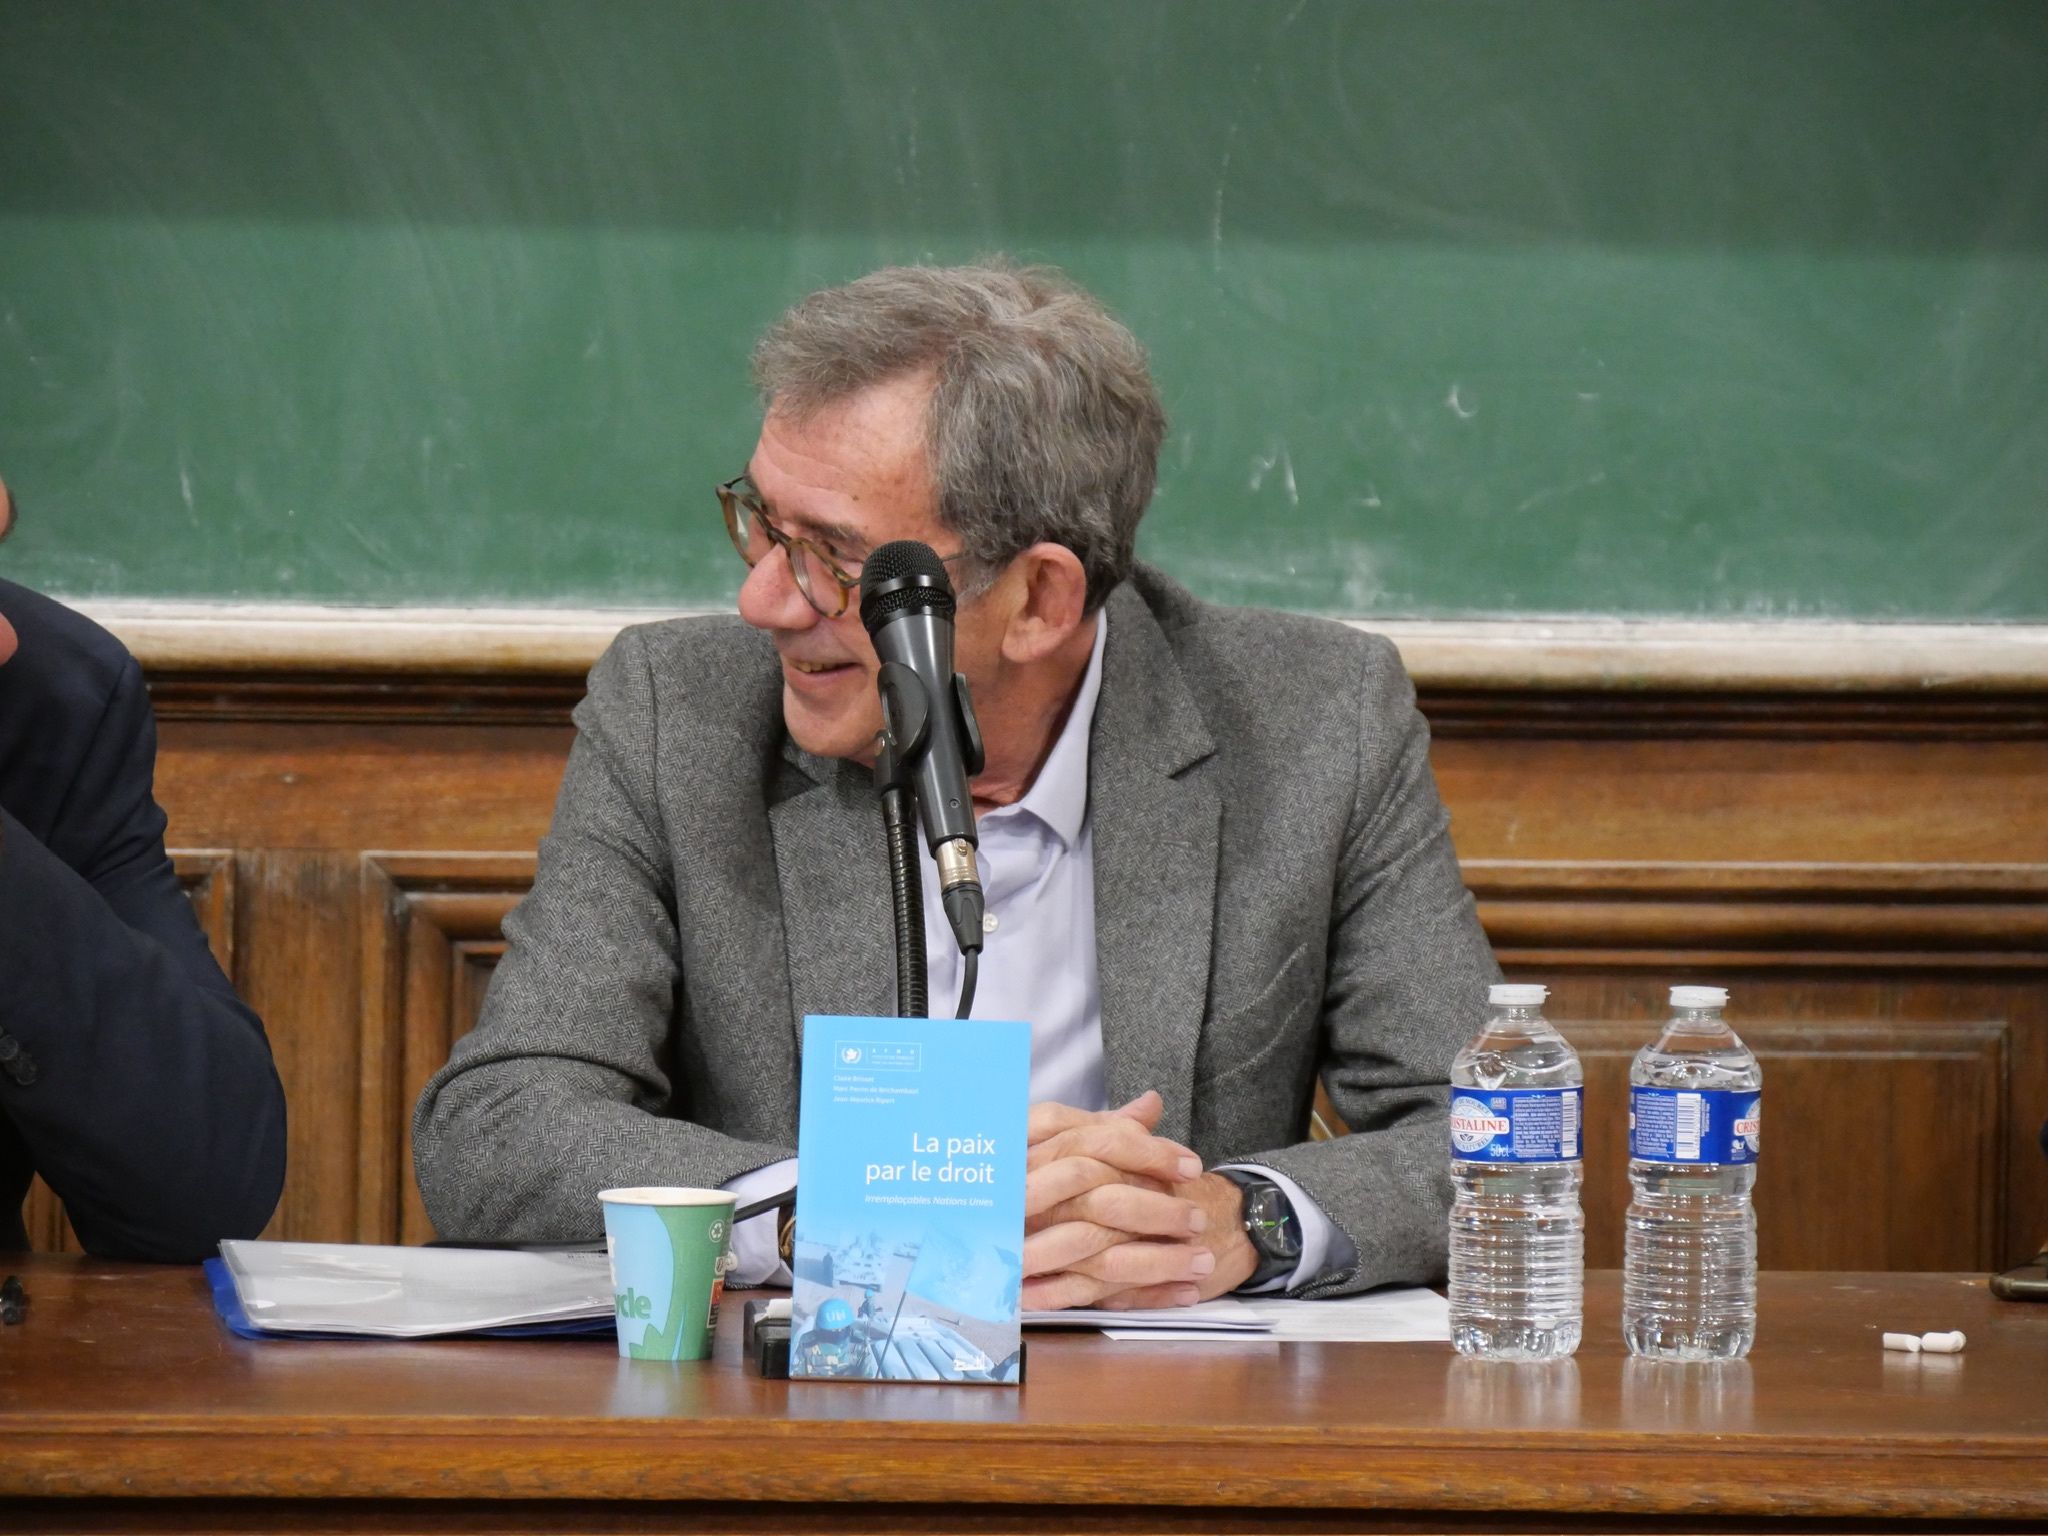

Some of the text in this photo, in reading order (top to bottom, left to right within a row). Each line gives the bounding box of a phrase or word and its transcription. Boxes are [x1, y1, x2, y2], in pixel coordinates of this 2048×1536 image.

[912, 1132, 995, 1159] La paix
[866, 1159, 995, 1185] par le droit
[932, 1196, 967, 1207] Nations
[969, 1197, 994, 1207] Unies
